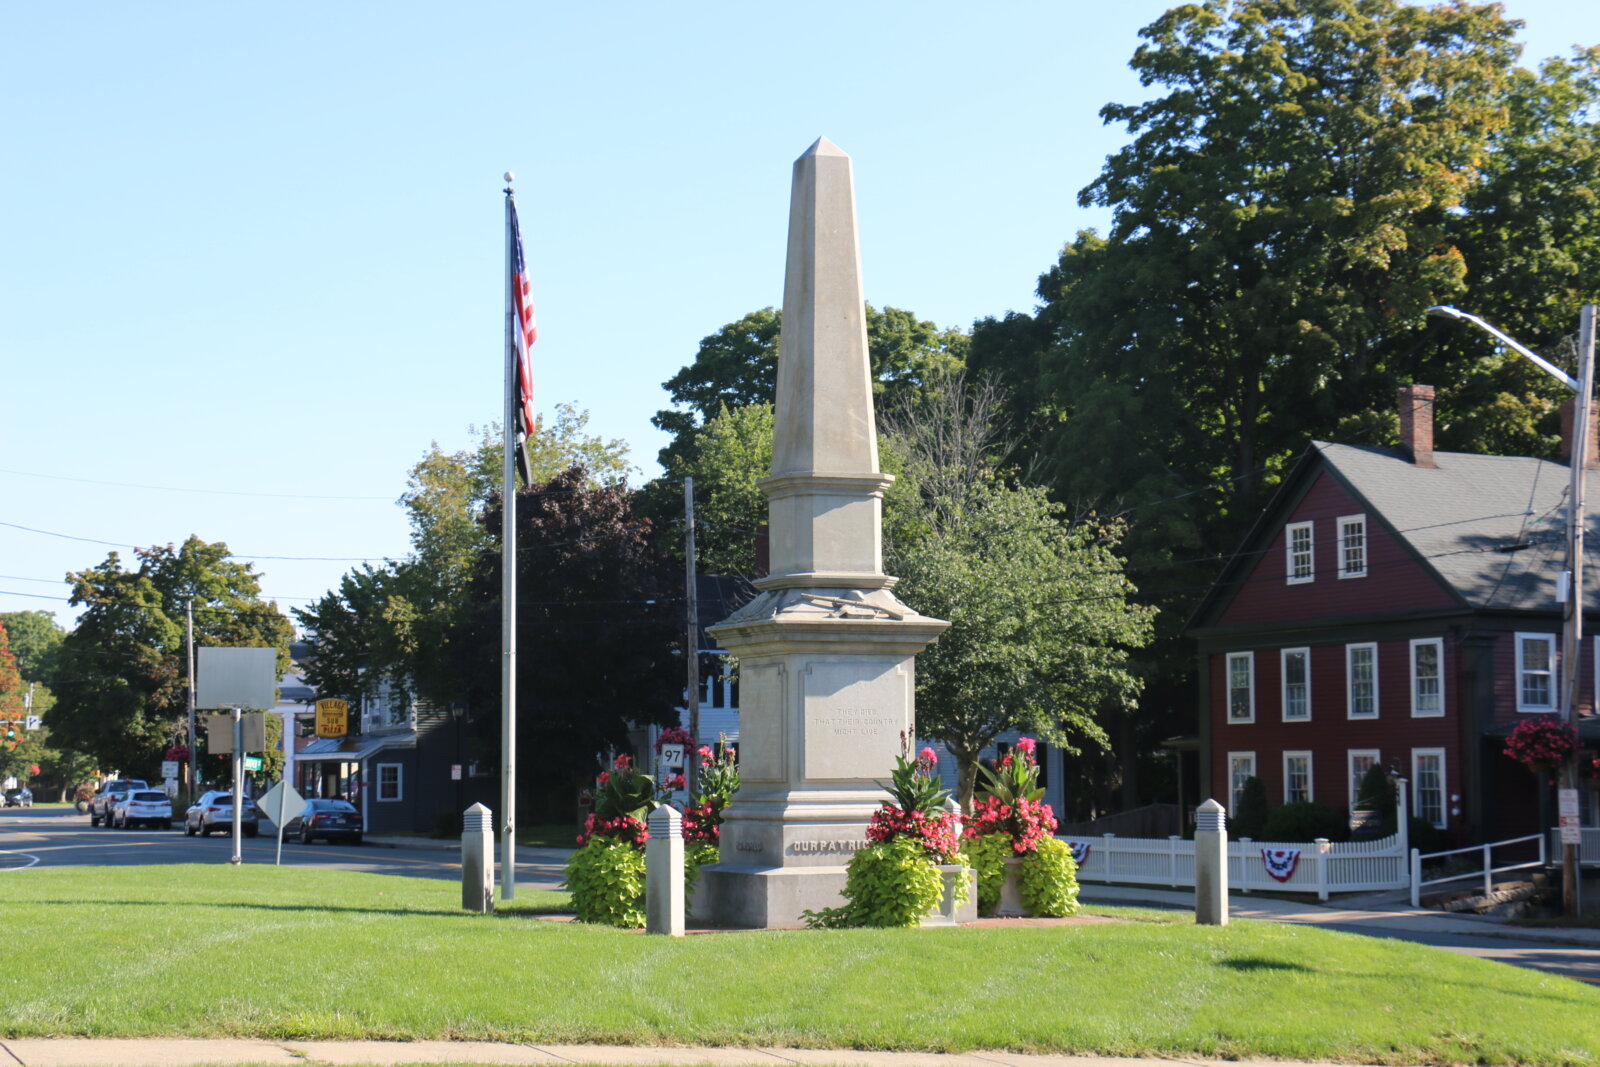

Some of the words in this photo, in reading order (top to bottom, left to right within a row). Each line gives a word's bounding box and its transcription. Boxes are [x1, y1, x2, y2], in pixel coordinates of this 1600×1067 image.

[814, 718, 835, 726] THAT
[837, 718, 860, 726] THEIR
[323, 726, 342, 734] PIZZA
[664, 750, 681, 763] 97
[794, 840, 817, 851] OUR
